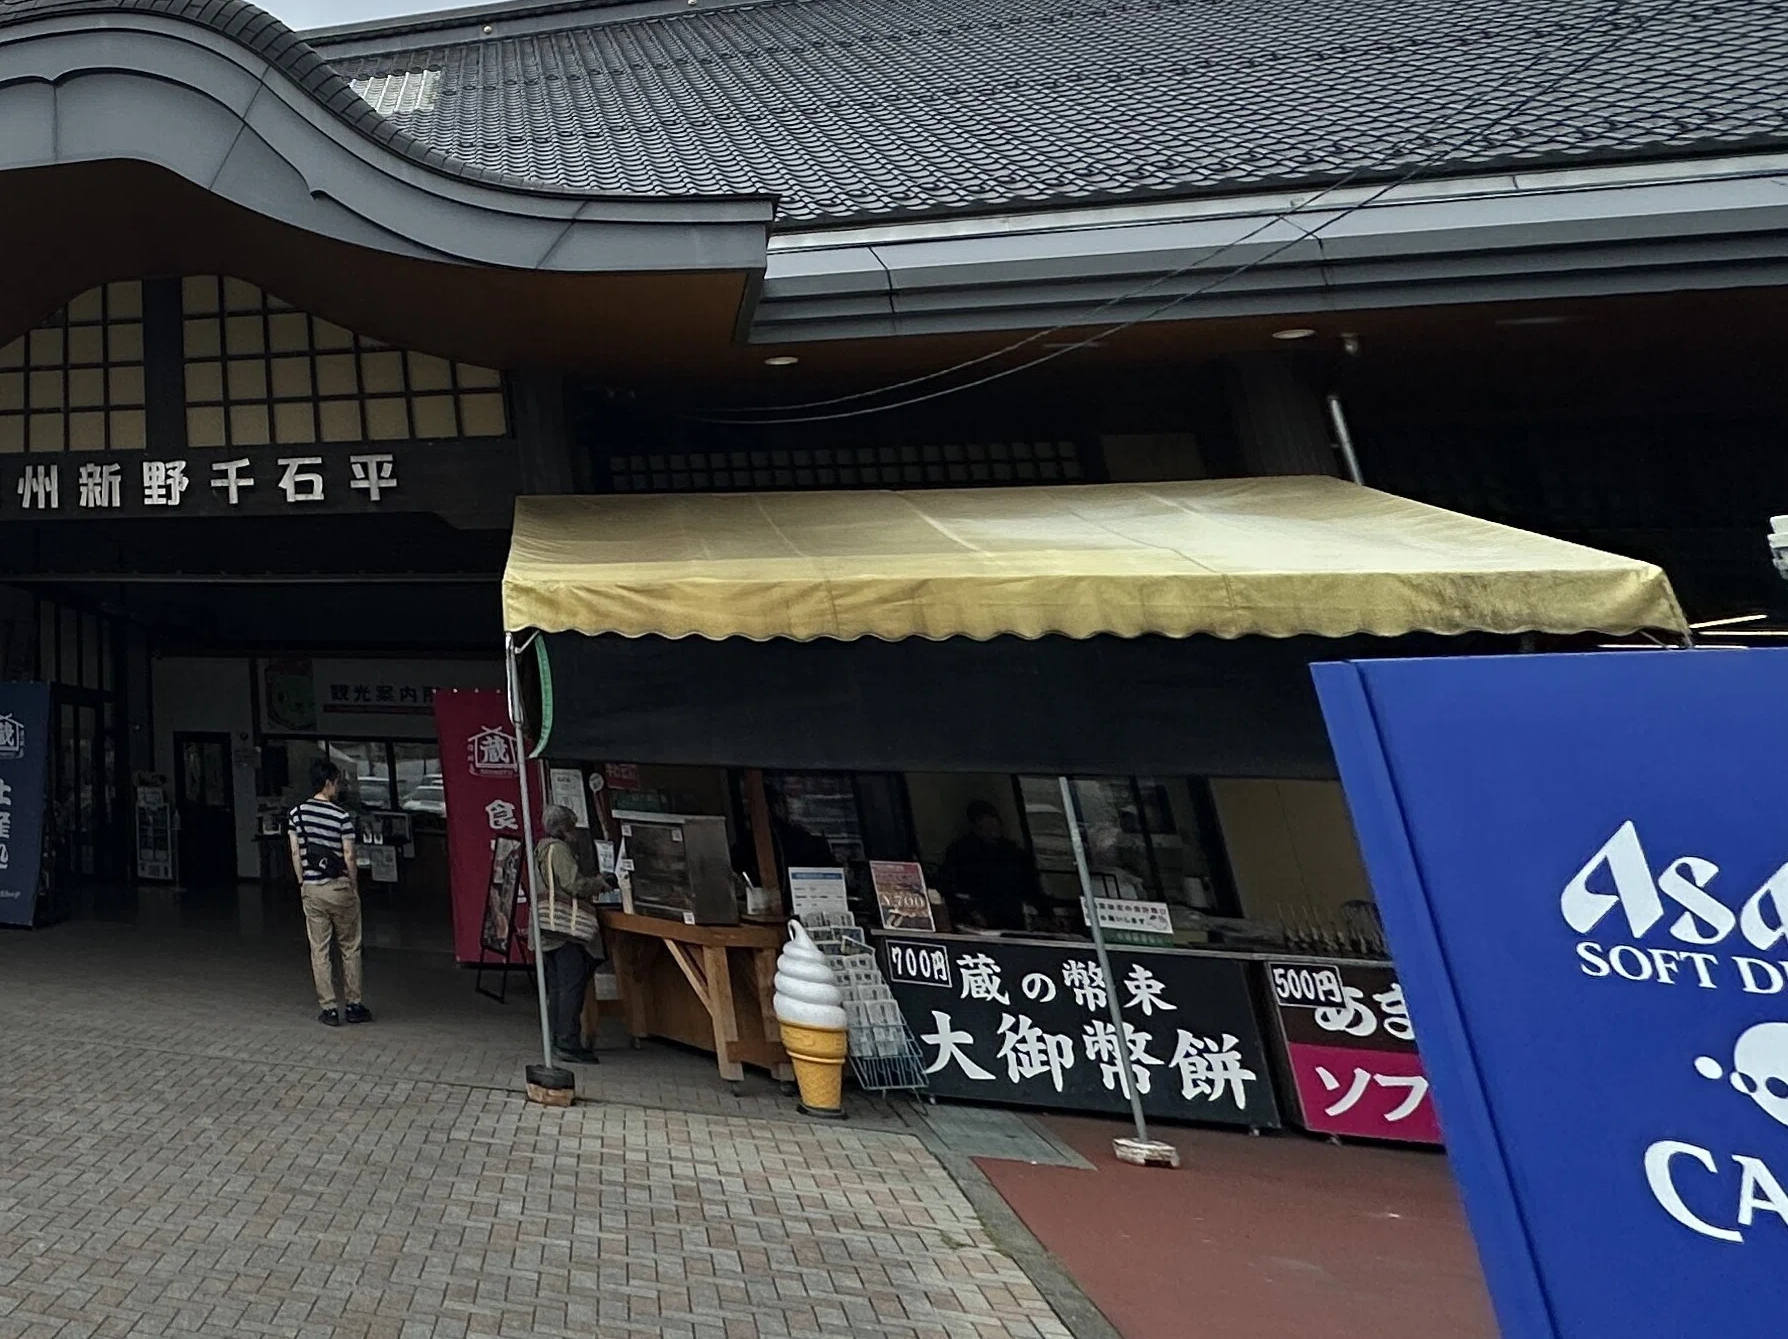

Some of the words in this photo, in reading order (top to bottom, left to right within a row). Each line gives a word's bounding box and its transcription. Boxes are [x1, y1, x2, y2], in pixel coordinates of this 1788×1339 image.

[891, 946, 948, 981] 700円
[1273, 968, 1343, 1003] 500円
[1575, 941, 1719, 989] SOFT
[1731, 955, 1788, 995] D
[920, 1009, 1257, 1111] 大御幣餅
[1315, 1066, 1429, 1122] ソフ
[1644, 1140, 1788, 1243] CA
